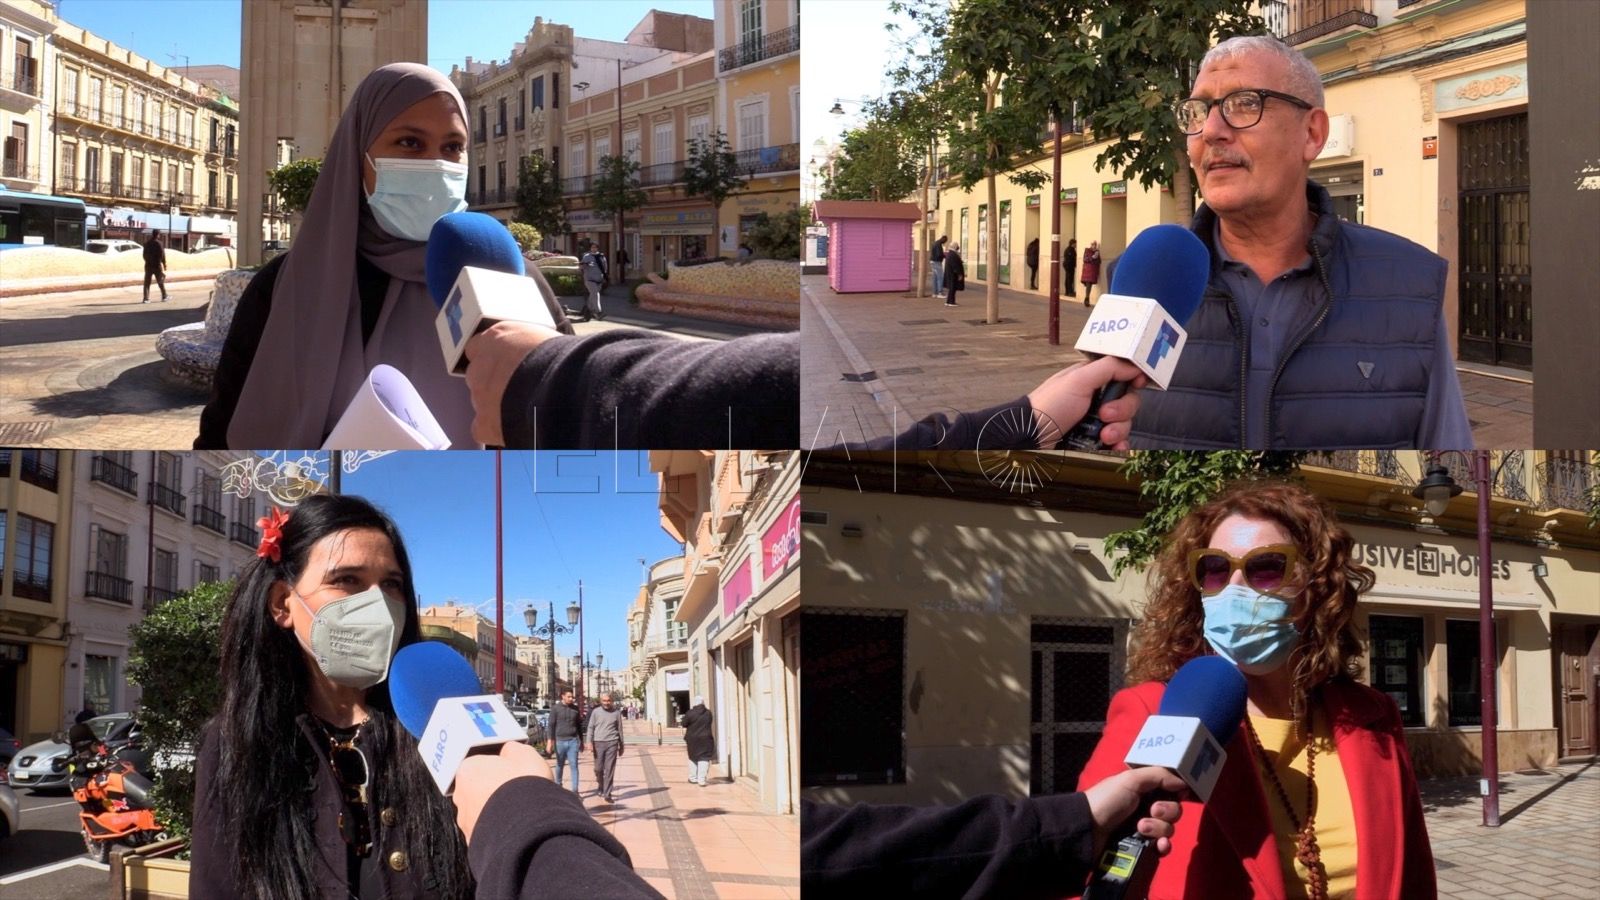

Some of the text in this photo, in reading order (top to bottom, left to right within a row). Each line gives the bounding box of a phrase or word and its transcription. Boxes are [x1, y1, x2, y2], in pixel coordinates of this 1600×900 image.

[1089, 318, 1129, 334] FARO
[1138, 734, 1176, 749] FARO
[432, 729, 448, 773] FARO
